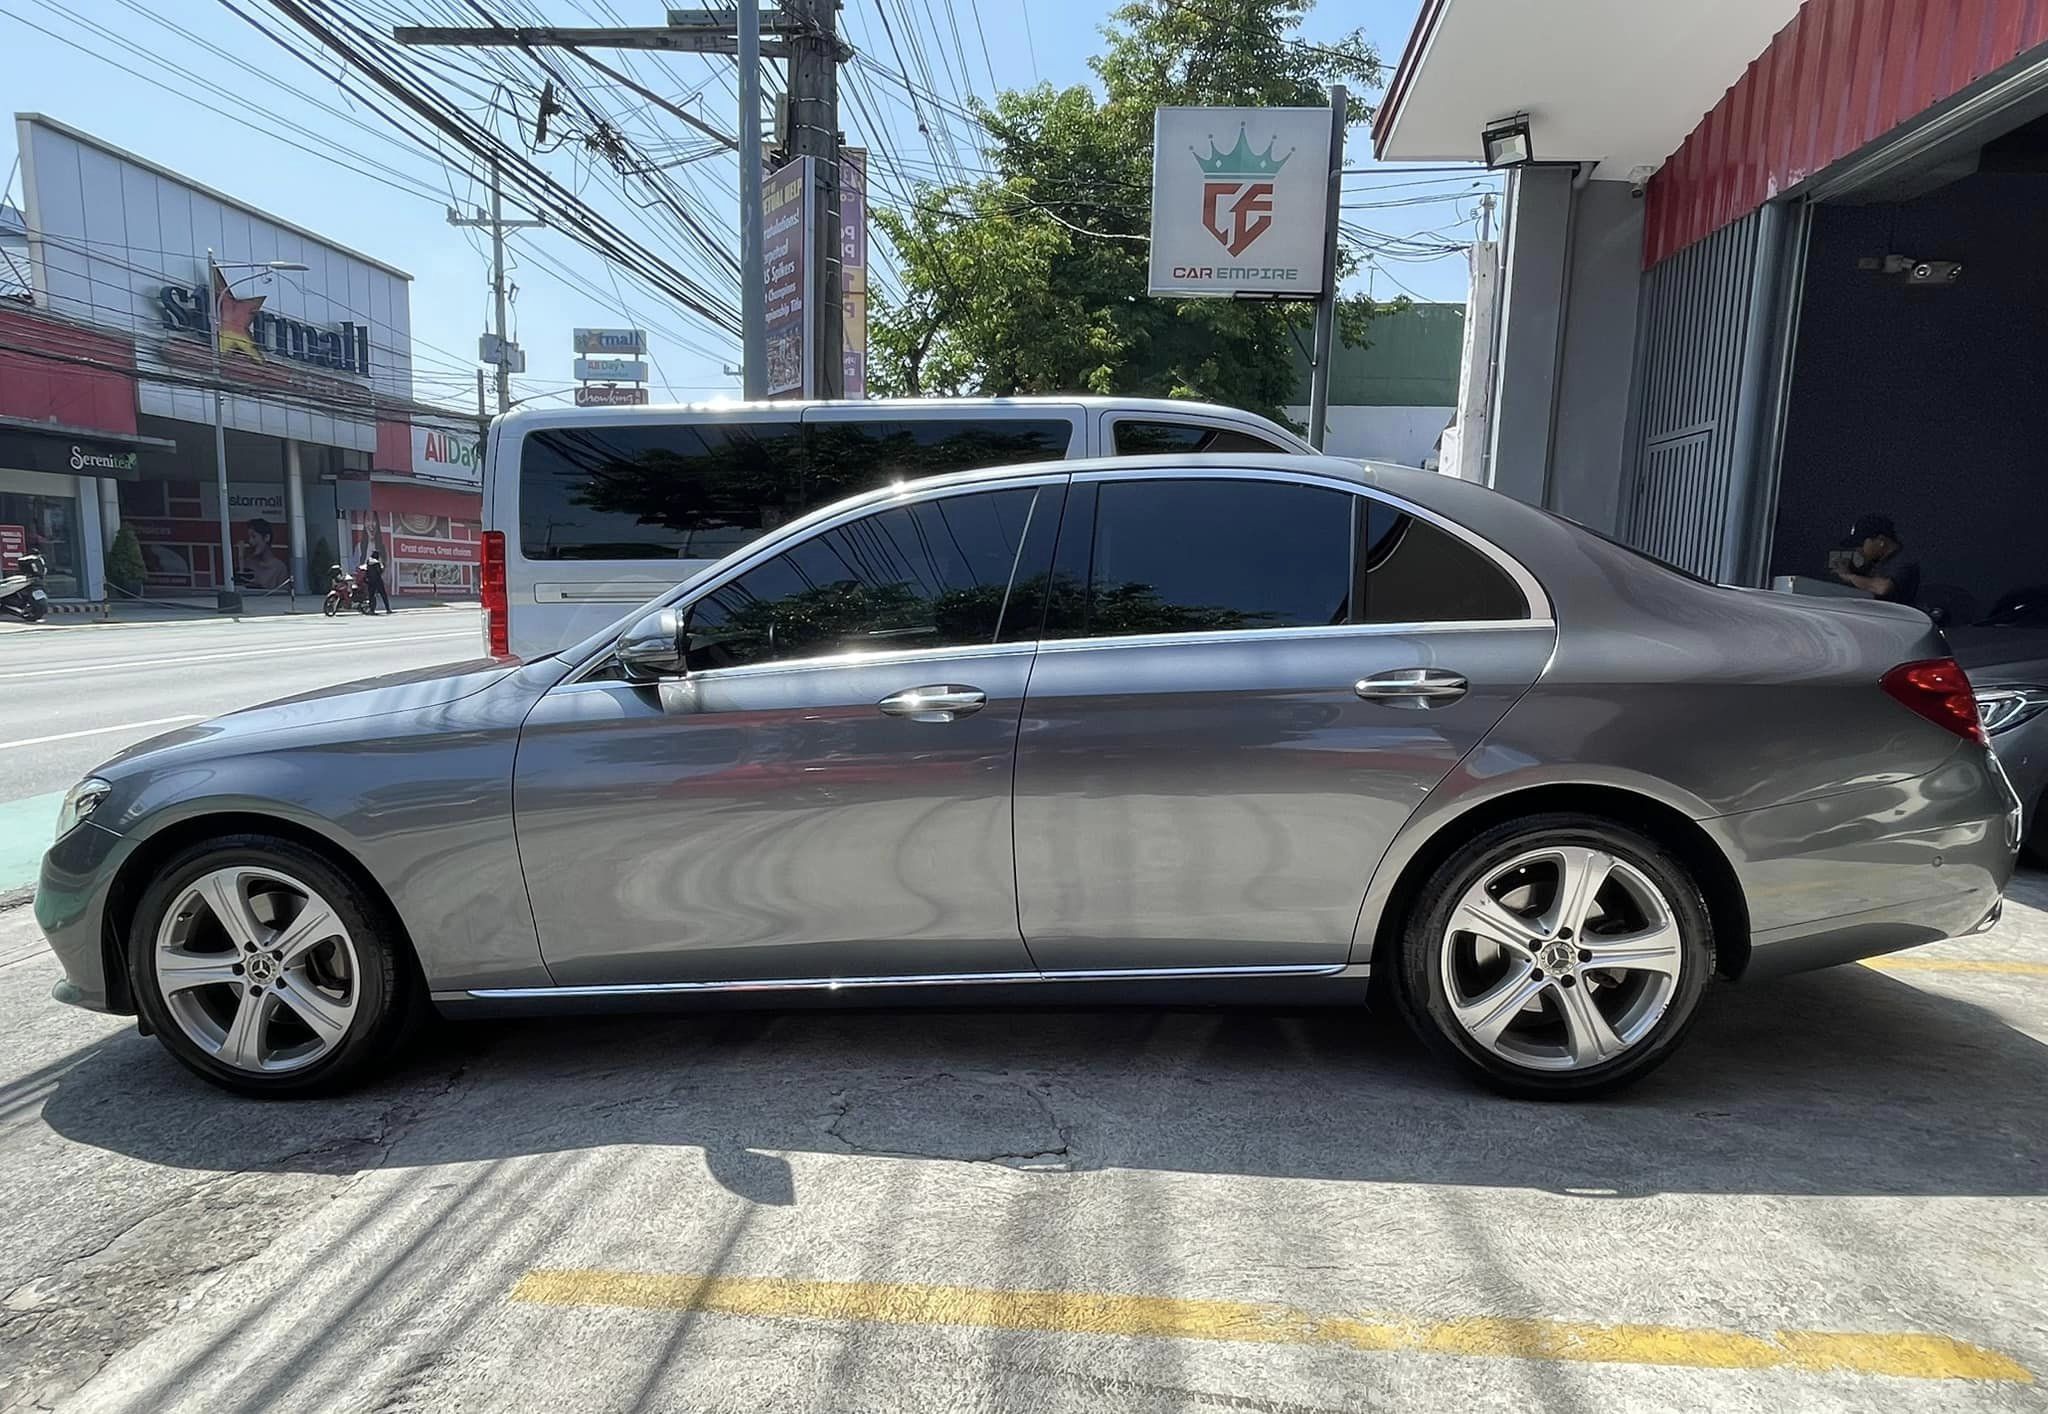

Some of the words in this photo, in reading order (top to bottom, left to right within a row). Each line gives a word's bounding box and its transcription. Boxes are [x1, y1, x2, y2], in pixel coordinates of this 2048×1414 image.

[1173, 267, 1212, 279] CAR
[1217, 267, 1298, 280] EMPIRE
[160, 284, 371, 378] Strmall
[577, 387, 634, 405] Chowking
[425, 432, 480, 474] AllDay
[229, 496, 283, 507] starmall
[400, 543, 417, 553] Great
[437, 546, 452, 556] Great
